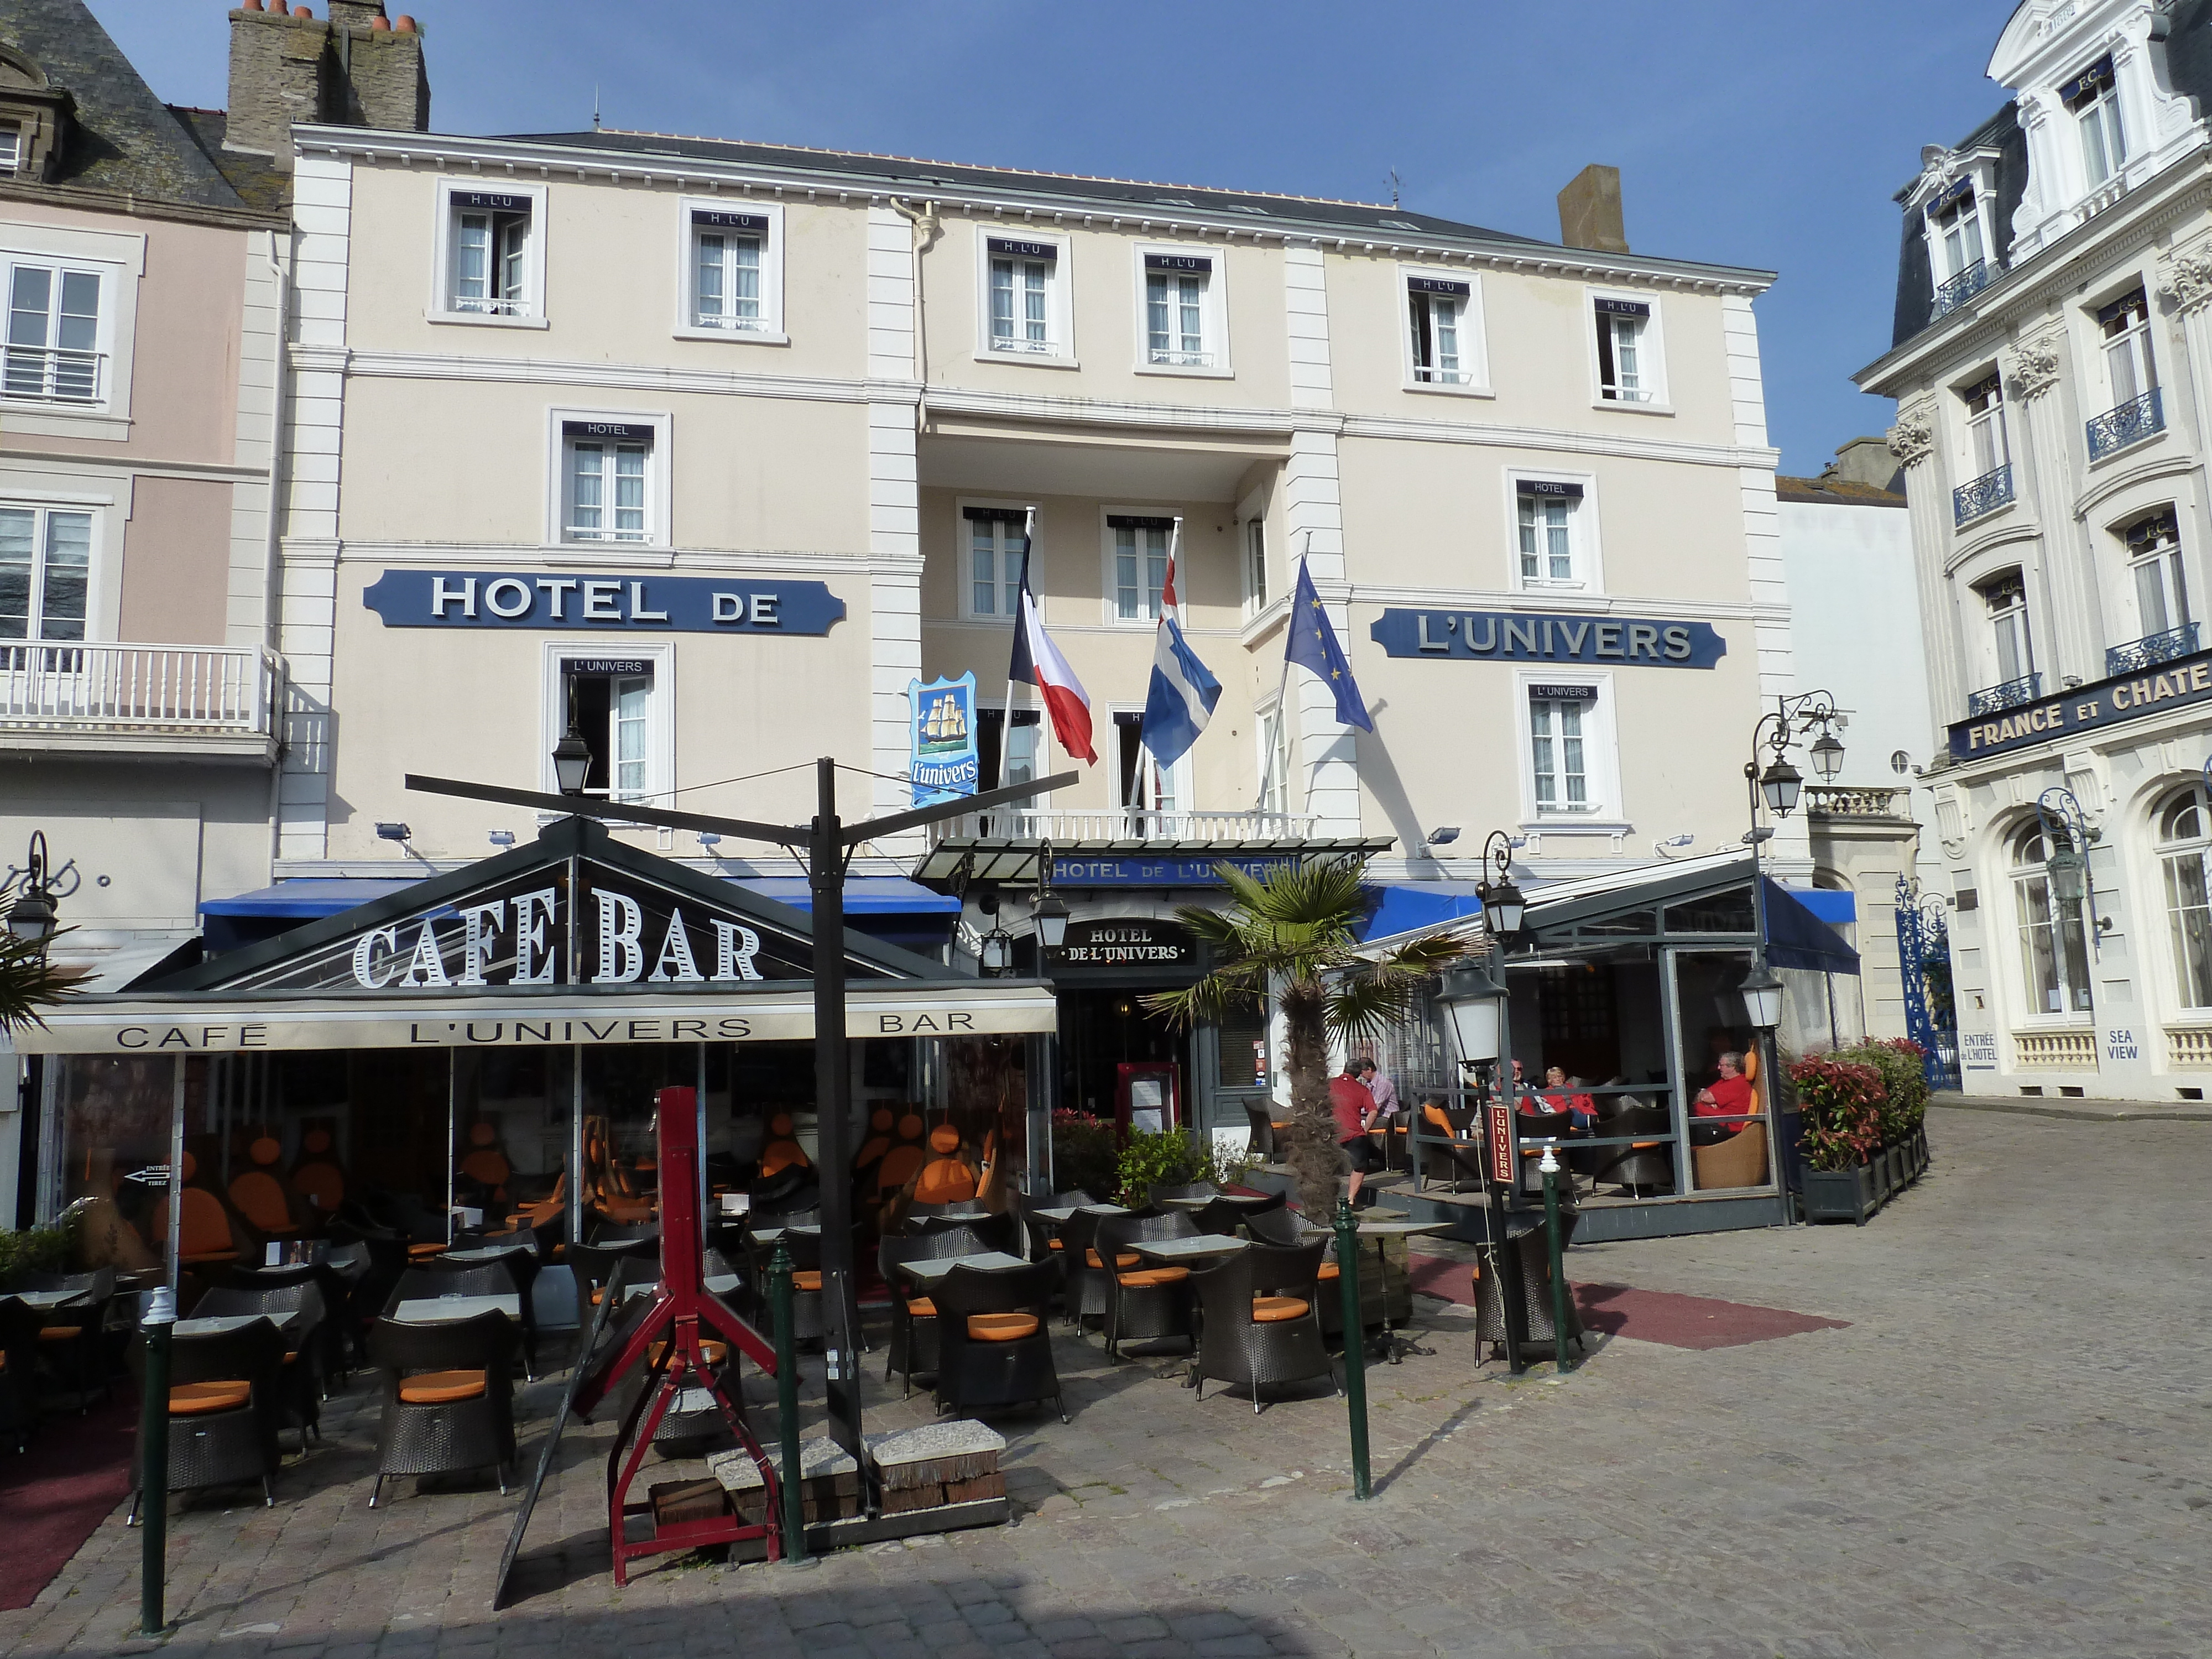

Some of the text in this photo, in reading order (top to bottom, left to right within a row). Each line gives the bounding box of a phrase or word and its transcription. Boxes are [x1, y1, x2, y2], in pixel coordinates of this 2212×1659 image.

[587, 424, 629, 435] HOTEL
[1534, 482, 1566, 493] HOTEL
[430, 577, 778, 624] HOTEL DE
[1417, 615, 1692, 659] L'UNIVERS
[1968, 662, 2211, 750] FRANCE ET CHATE
[913, 760, 976, 785] l'univers
[1053, 863, 1128, 878] HOTEL
[1142, 866, 1164, 878] DE
[352, 886, 764, 989] CAFE BAR
[1090, 928, 1152, 942] HOTEL
[116, 1013, 976, 1047] CAFÉ L'UNIVERS BAR
[1964, 1031, 1994, 1046] ENTRÉE
[2110, 1030, 2133, 1043] SEA
[2107, 1046, 2138, 1059] VIEW
[1496, 1109, 1509, 1177] L'UNIVERS
